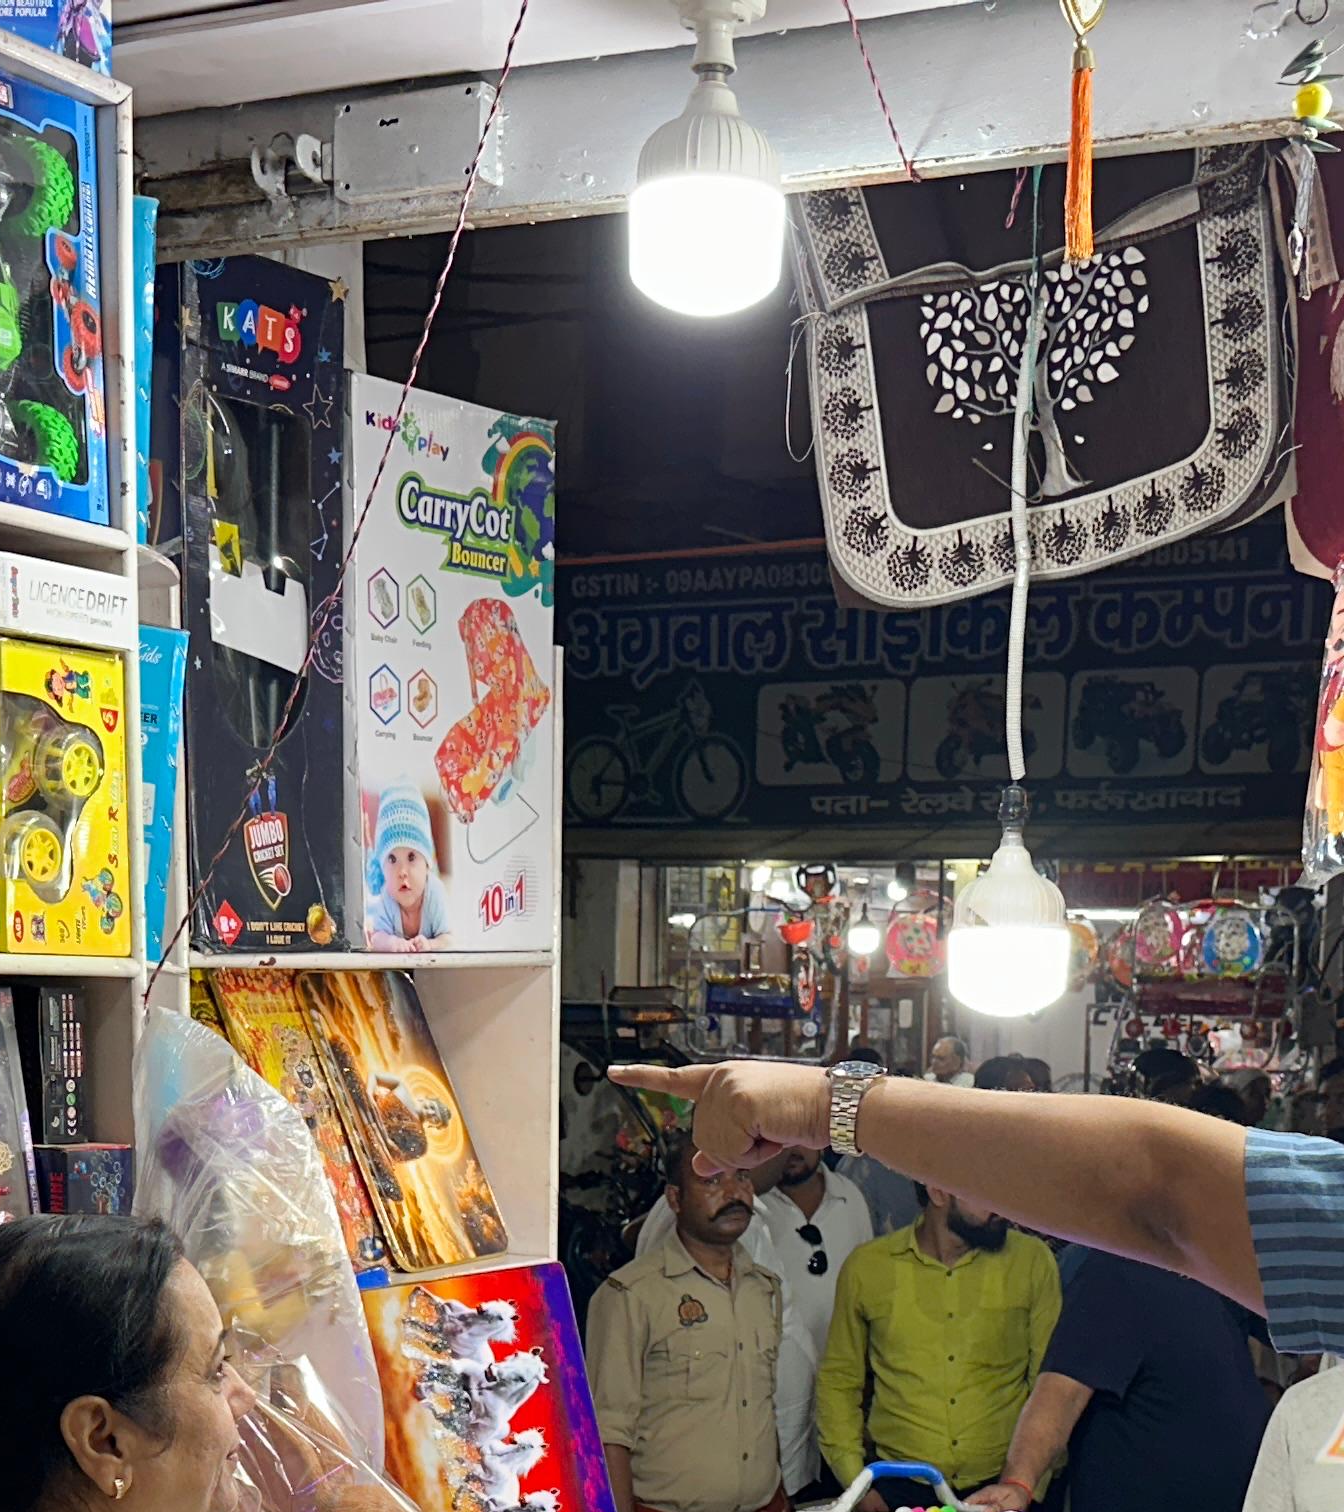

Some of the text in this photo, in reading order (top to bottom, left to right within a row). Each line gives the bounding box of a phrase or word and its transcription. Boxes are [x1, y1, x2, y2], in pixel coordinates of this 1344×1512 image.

[14, 7, 47, 18] POPULAR
[223, 306, 295, 353] KATS
[452, 542, 506, 573] Bouncer
[571, 561, 833, 598] GSTIN 09AAYPA0830
[248, 819, 284, 849] JUMBO
